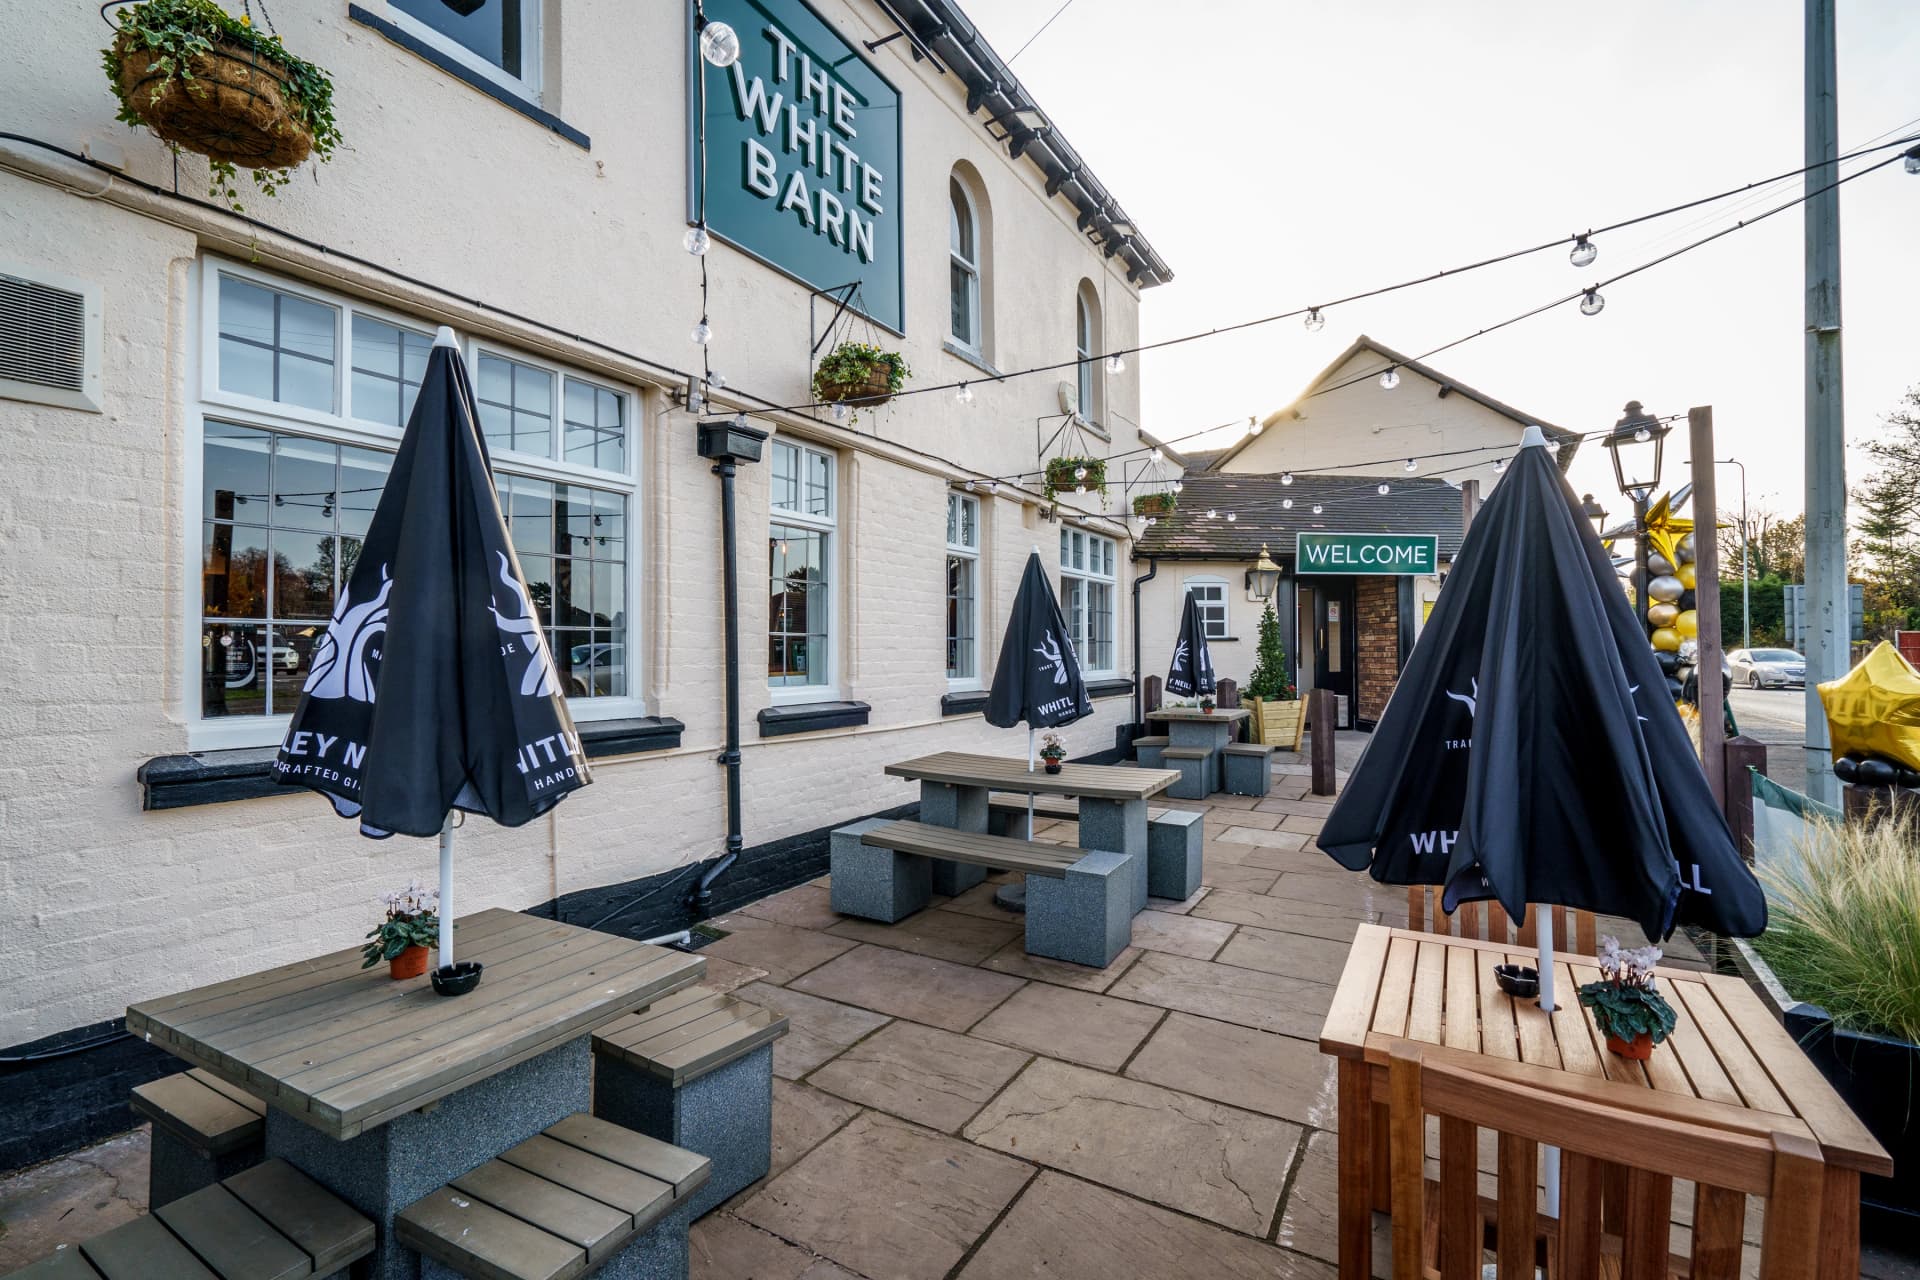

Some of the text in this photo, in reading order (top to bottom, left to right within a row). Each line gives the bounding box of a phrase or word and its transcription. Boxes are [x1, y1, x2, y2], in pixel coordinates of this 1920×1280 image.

[731, 59, 884, 215] WHITE
[768, 24, 857, 138] THE
[747, 137, 875, 263] BARN
[1305, 544, 1429, 564] WELCOME
